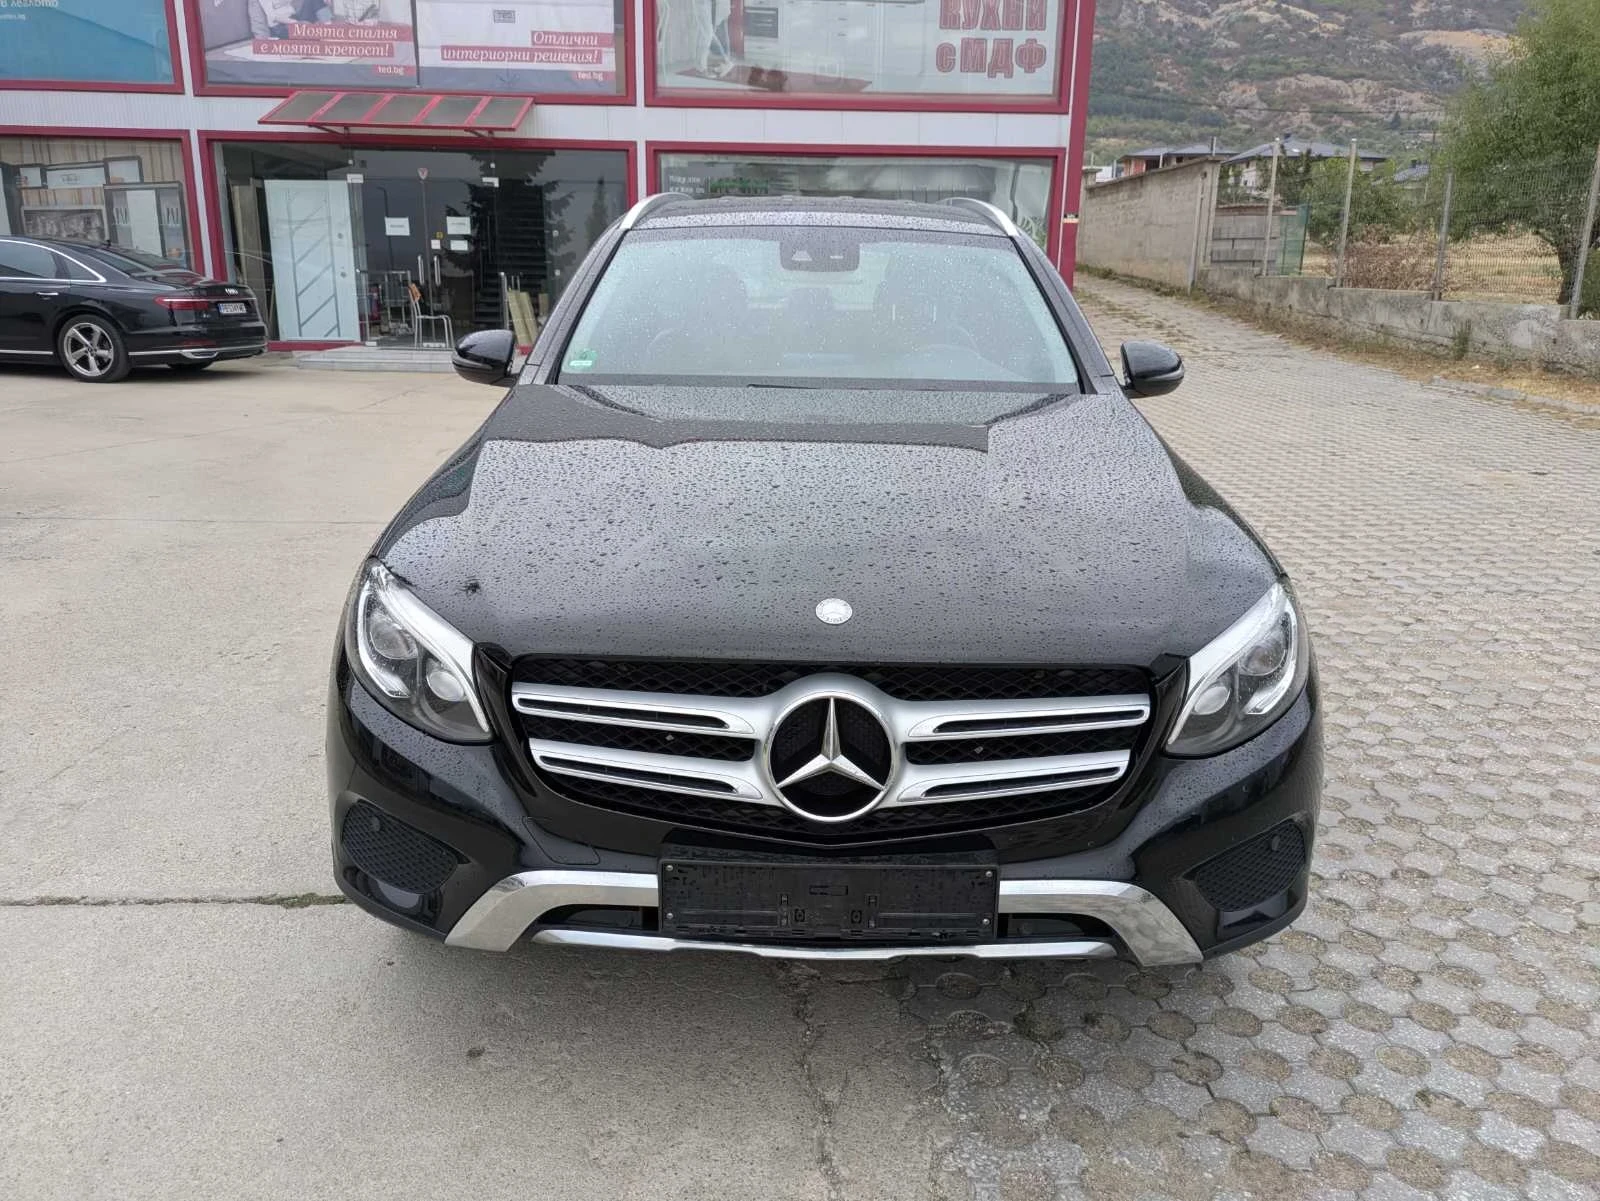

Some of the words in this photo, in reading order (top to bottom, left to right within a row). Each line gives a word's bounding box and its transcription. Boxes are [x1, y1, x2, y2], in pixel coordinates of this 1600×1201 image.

[939, 0, 1047, 31] КУХНИ
[293, 23, 345, 39] Моята
[348, 27, 398, 39] спалня
[533, 31, 598, 46] Отлични
[271, 45, 321, 54] моята
[324, 44, 390, 58] крепост!
[443, 49, 530, 64] интериорни
[534, 50, 598, 64] решения!
